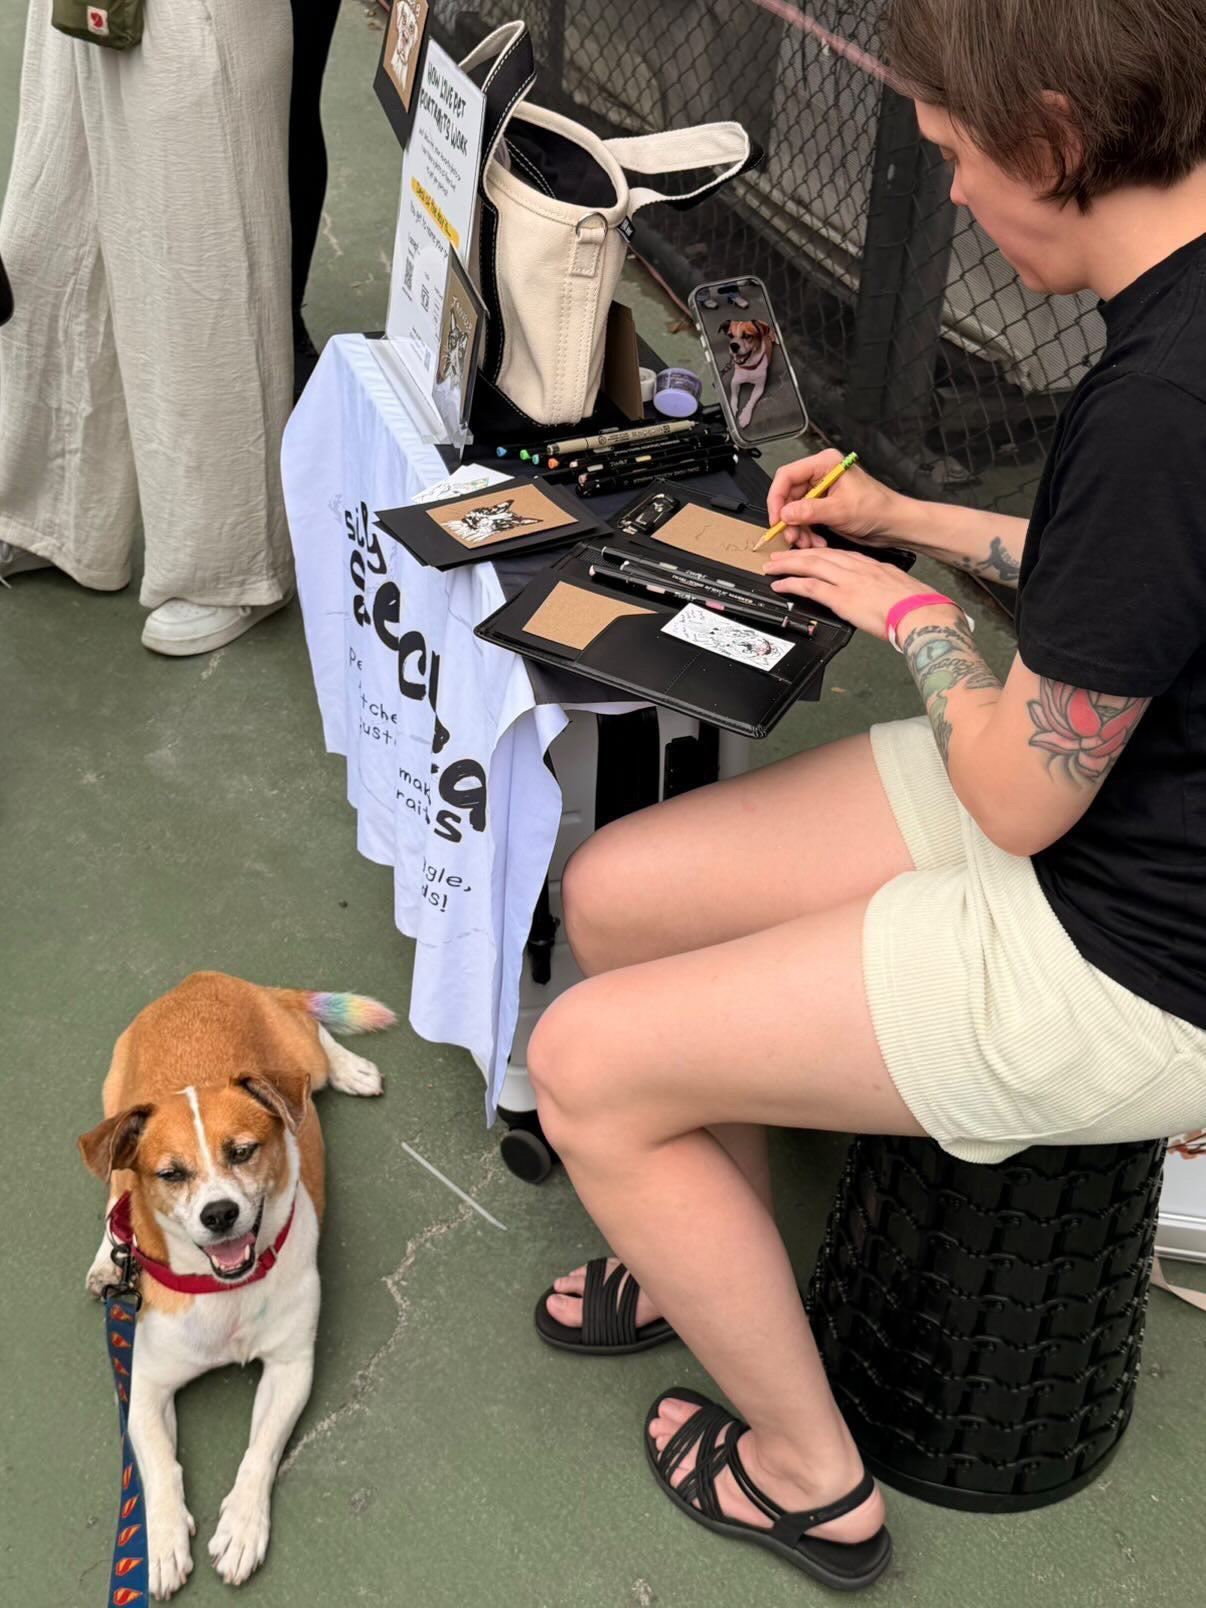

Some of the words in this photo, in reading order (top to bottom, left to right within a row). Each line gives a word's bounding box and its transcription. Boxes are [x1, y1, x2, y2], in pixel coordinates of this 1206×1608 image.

[439, 75, 454, 109] LIVE
[420, 88, 451, 141] PORTRAITS
[450, 121, 468, 157] WORK
